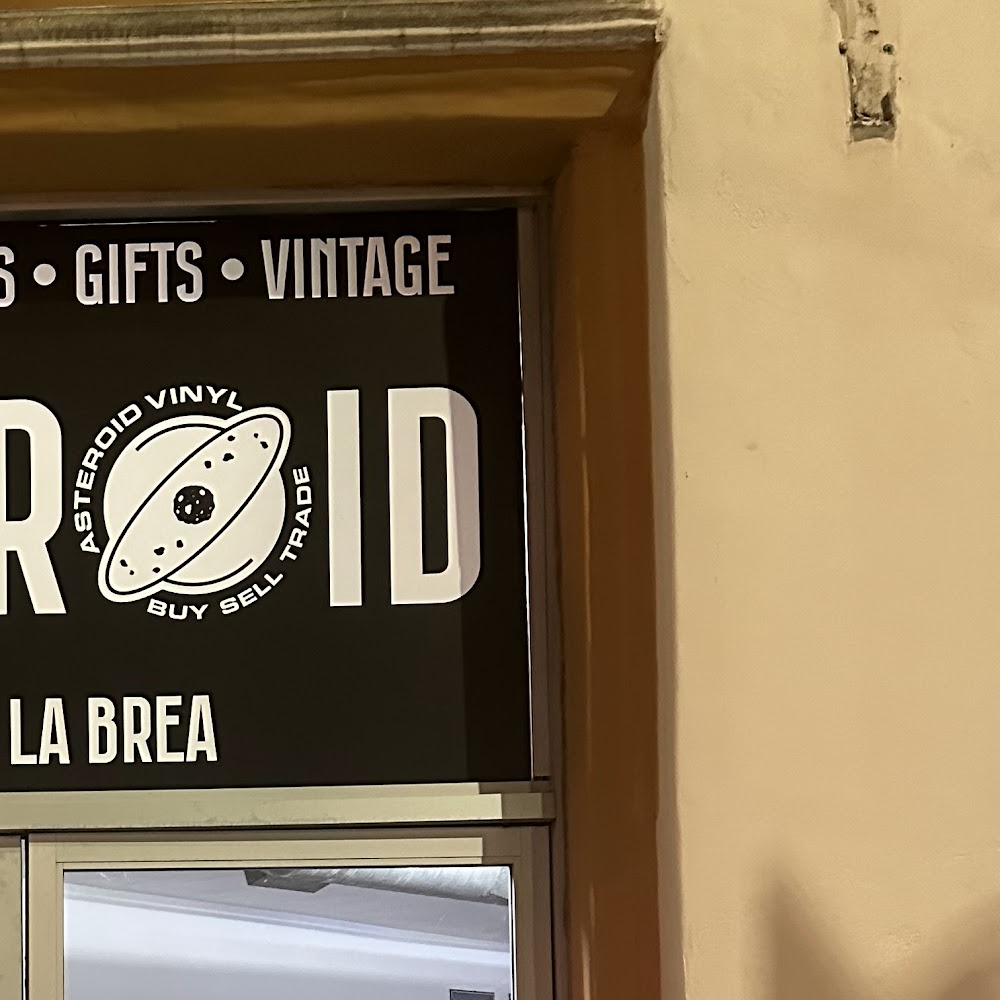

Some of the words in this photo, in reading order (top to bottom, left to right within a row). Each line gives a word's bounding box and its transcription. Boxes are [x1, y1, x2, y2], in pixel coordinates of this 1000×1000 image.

[75, 241, 203, 306] GIFTS
[260, 234, 455, 300] VINTAGE
[73, 403, 143, 554] ASTEROID
[143, 384, 243, 412] VINYL
[146, 597, 209, 620] BUY
[219, 573, 284, 615] SELL
[279, 466, 313, 562] TRADE
[9, 697, 71, 765] LA
[87, 694, 218, 764] BREA
